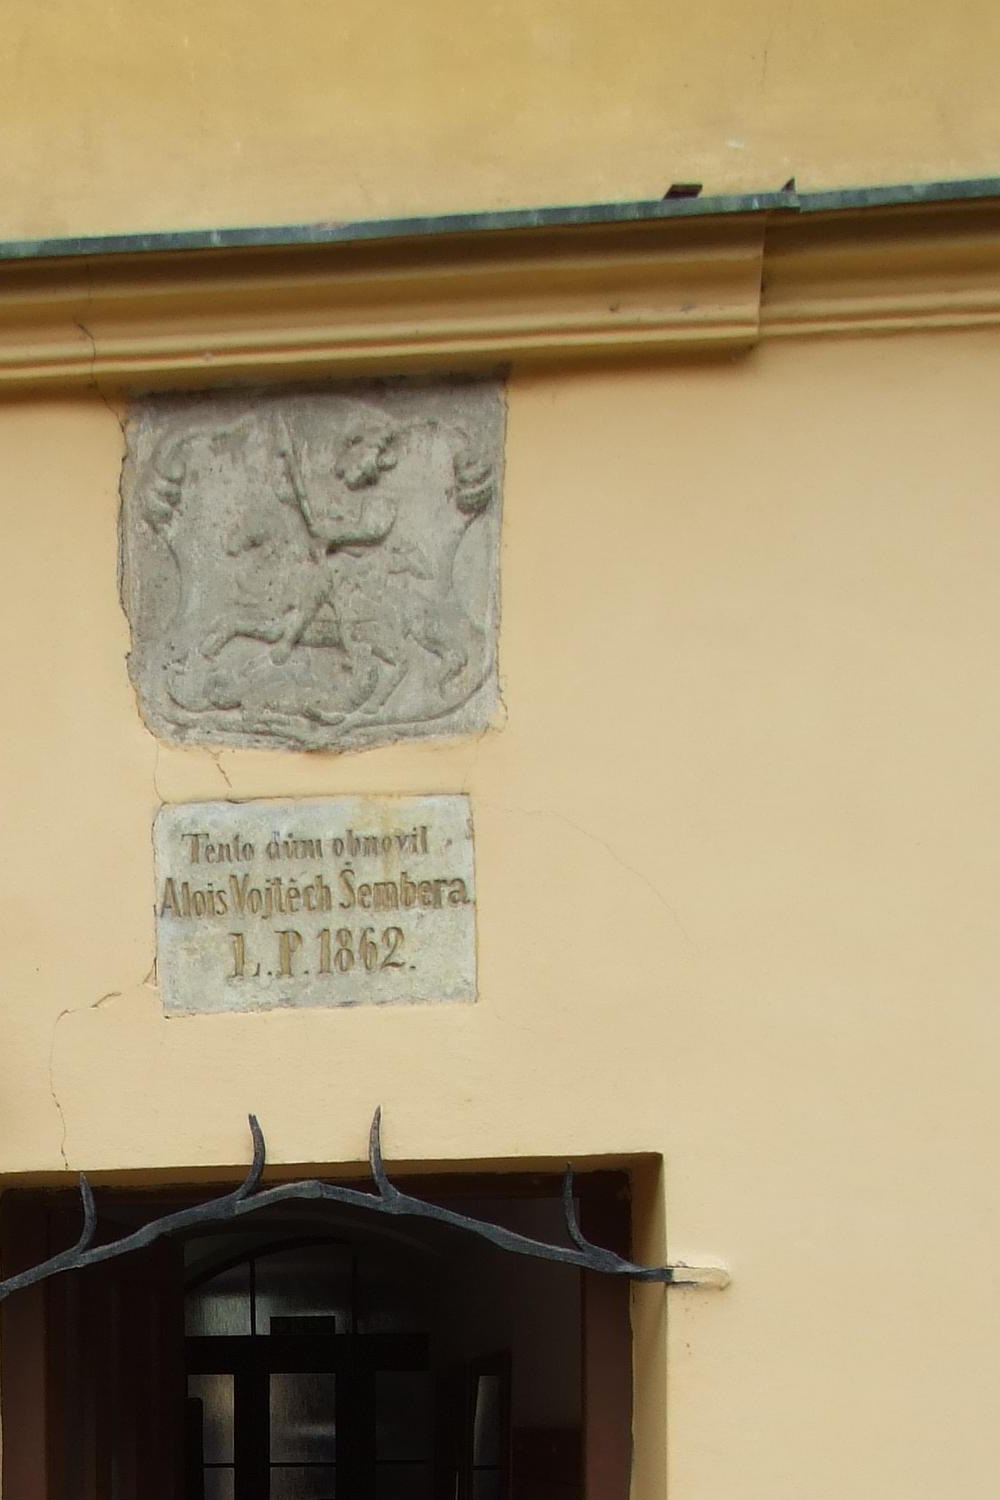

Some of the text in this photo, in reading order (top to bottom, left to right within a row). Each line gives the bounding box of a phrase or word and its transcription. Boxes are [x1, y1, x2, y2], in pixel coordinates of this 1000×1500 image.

[181, 832, 255, 865] Tento
[332, 825, 428, 857] obnovil
[160, 861, 470, 920] Alois Vojtěch Šembera
